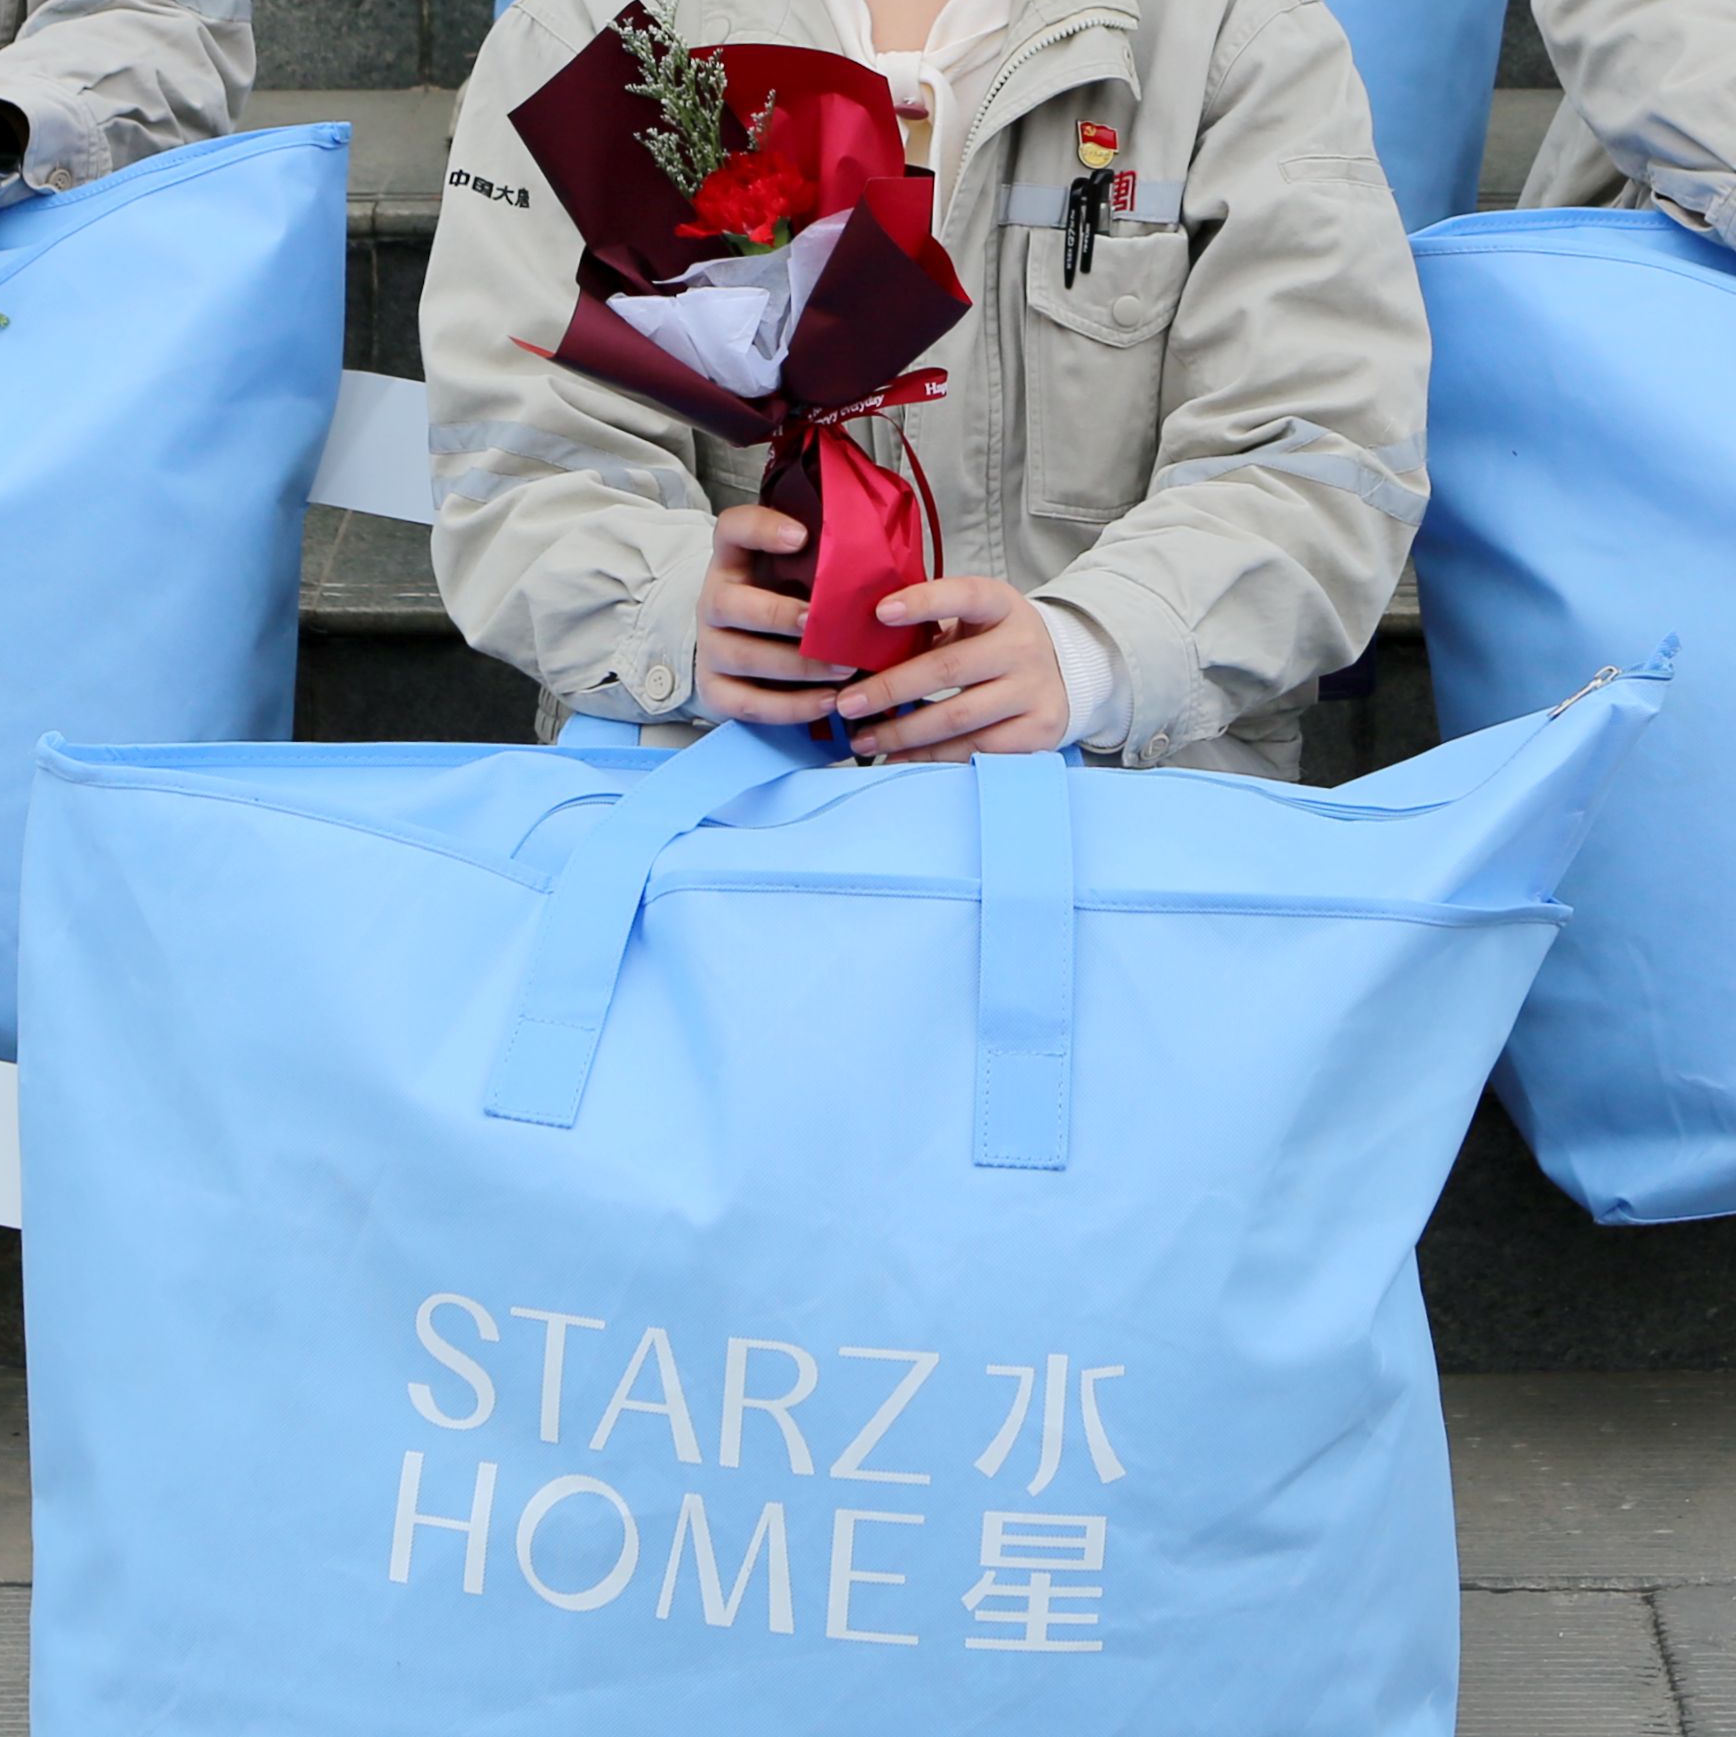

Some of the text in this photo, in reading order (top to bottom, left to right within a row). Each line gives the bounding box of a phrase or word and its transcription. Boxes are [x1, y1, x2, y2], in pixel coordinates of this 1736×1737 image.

[449, 169, 531, 209] 中国大唐
[407, 1292, 1127, 1498] STARZ 水
[388, 1450, 1107, 1652] HOME 星
